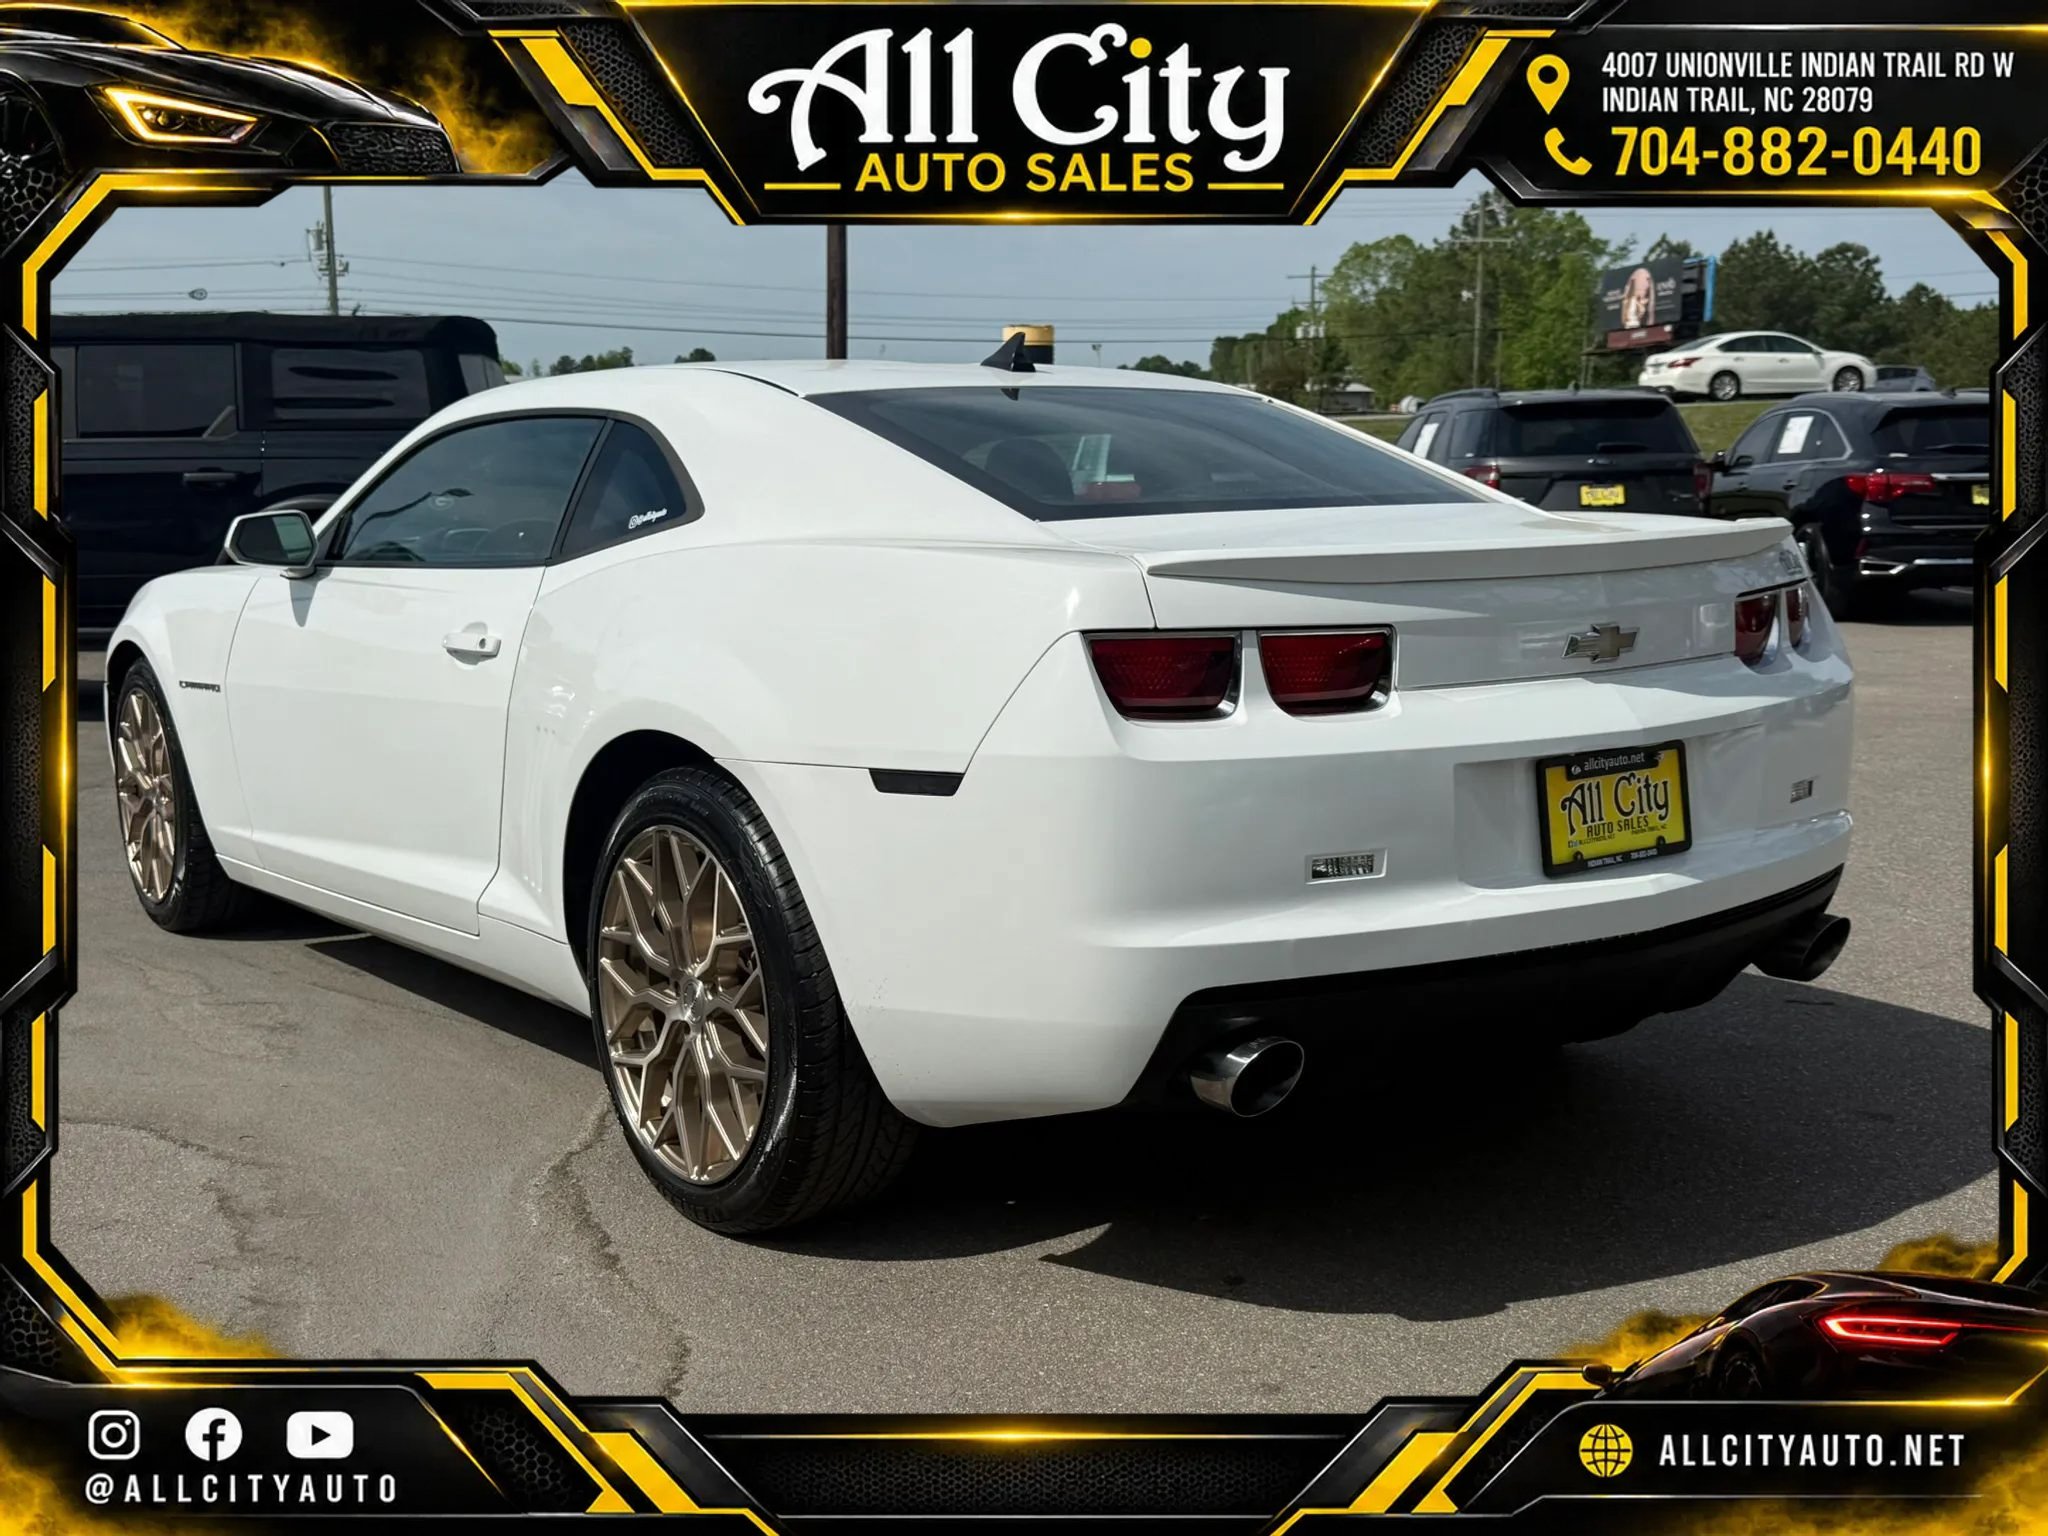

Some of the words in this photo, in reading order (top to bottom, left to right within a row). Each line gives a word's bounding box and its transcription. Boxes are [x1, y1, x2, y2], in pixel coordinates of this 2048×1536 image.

[1583, 752, 1645, 771] allcityauto.net
[1560, 781, 1604, 836] All
[1614, 772, 1669, 821] City
[1587, 821, 1614, 838] AUTO
[1617, 815, 1649, 833] SALES
